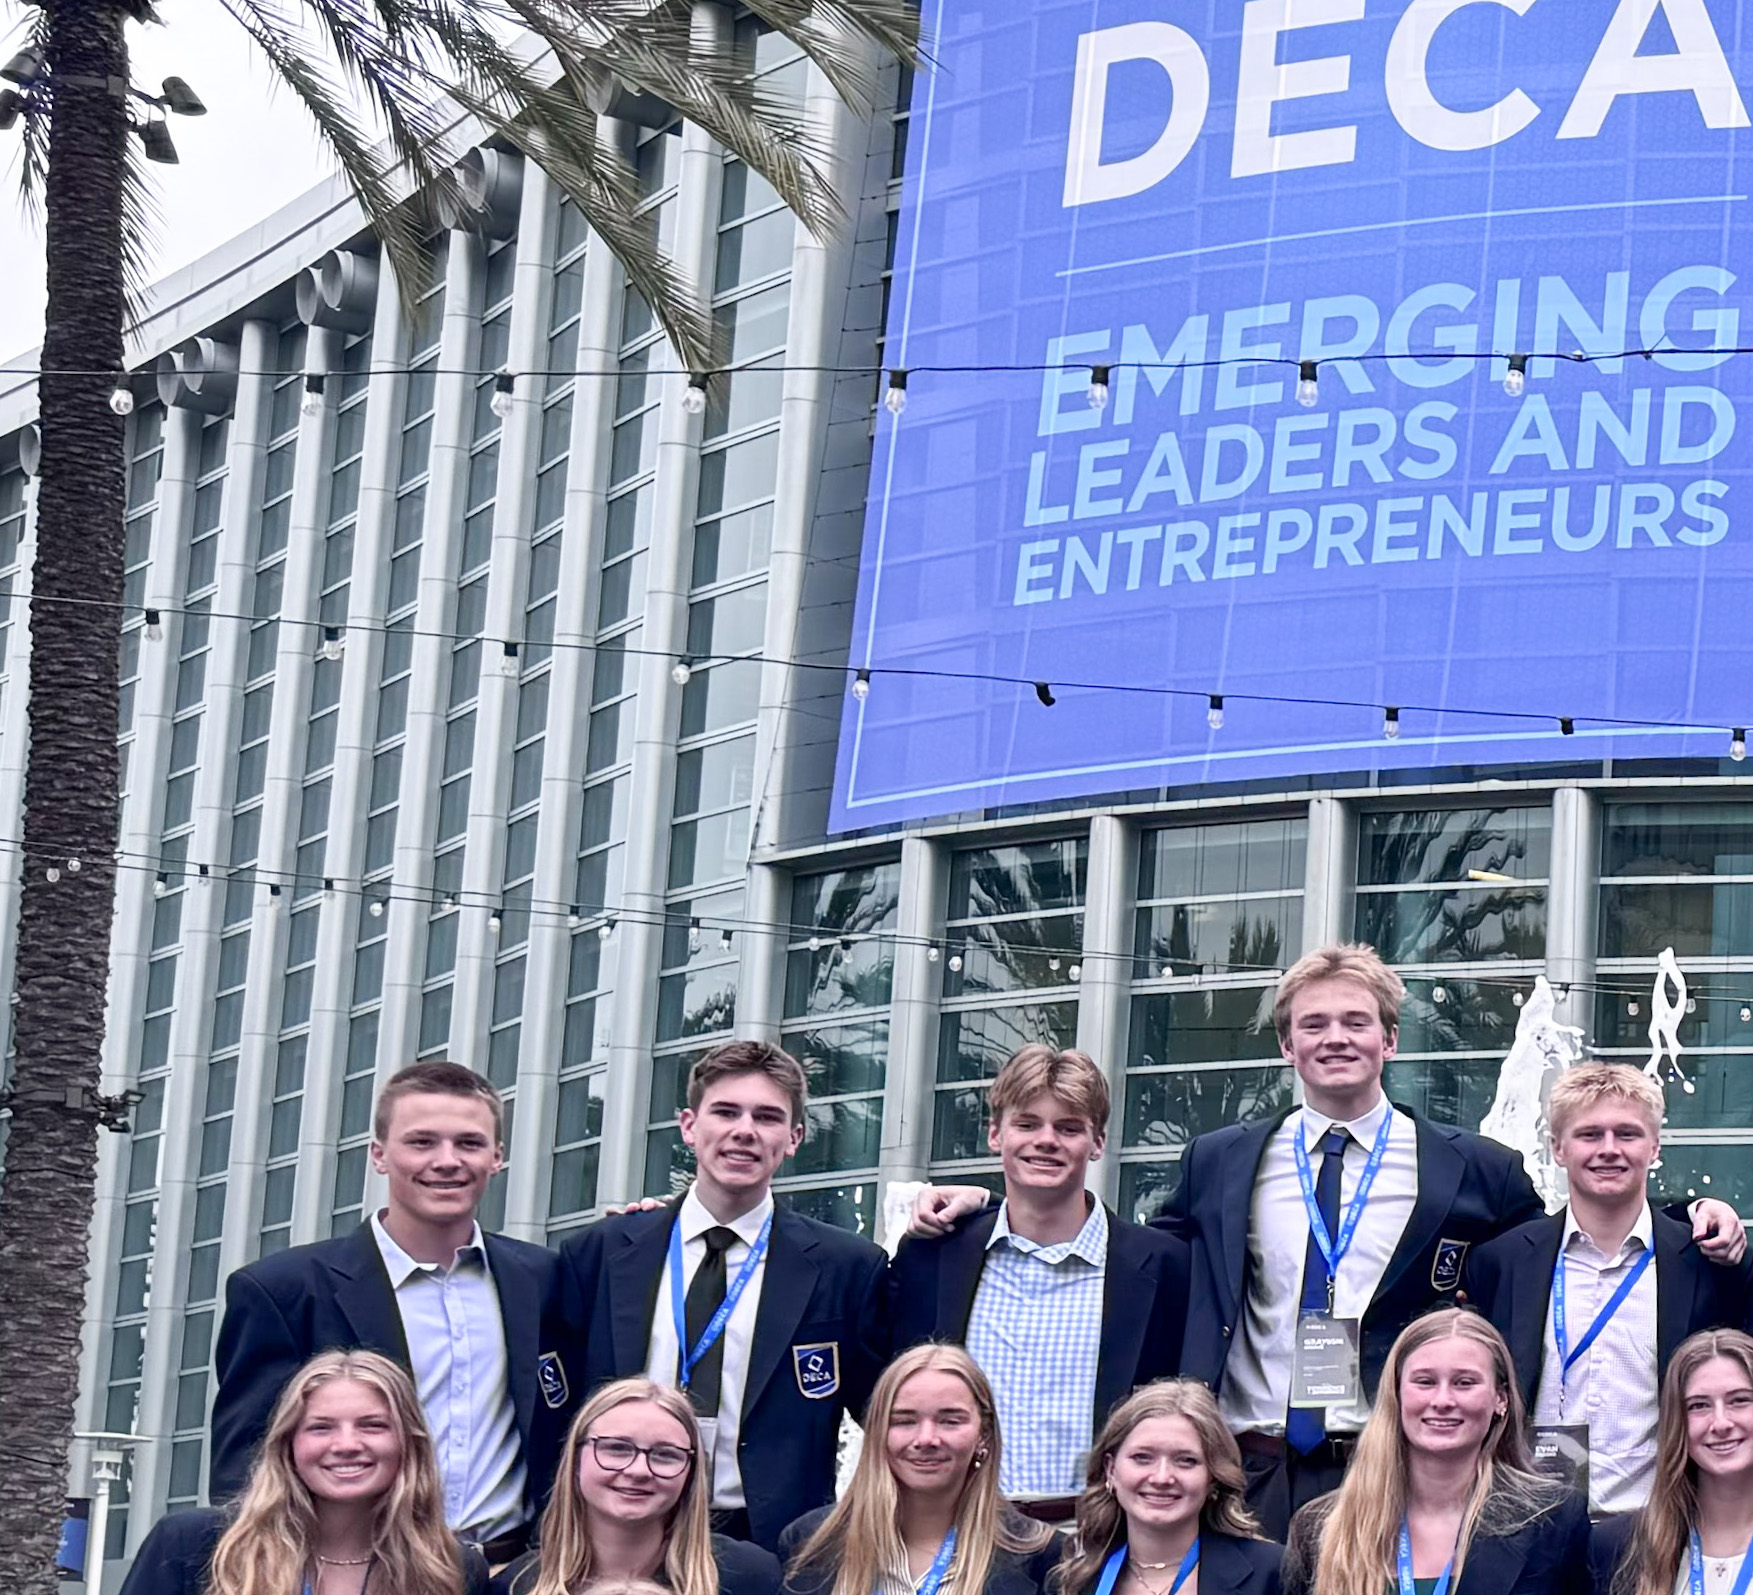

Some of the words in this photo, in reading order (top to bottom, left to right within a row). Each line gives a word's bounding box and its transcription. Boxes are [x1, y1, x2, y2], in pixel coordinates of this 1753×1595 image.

[1062, 0, 1752, 207] DECA
[1037, 265, 1740, 437] EMERGING
[1024, 397, 1459, 528] LEADERS
[1489, 384, 1738, 477] AND
[1012, 476, 1731, 607] ENTREPRENEURS
